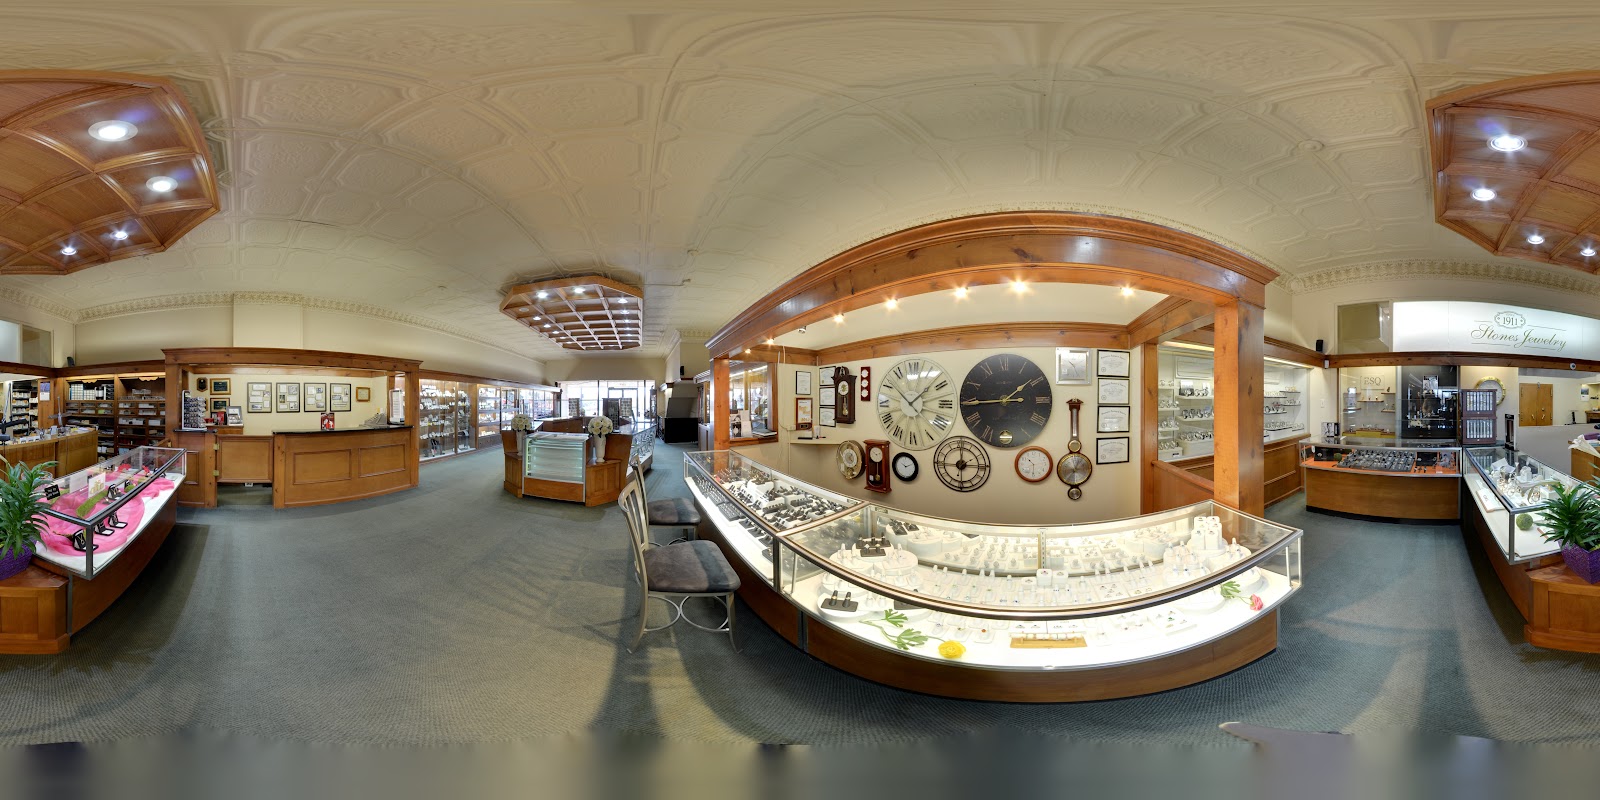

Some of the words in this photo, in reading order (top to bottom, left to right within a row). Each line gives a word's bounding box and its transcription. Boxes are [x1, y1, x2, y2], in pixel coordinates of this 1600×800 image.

[1502, 316, 1518, 326] 1911
[1471, 324, 1519, 342] Stones
[1514, 329, 1567, 352] Jewelry
[1363, 376, 1382, 386] ESQ
